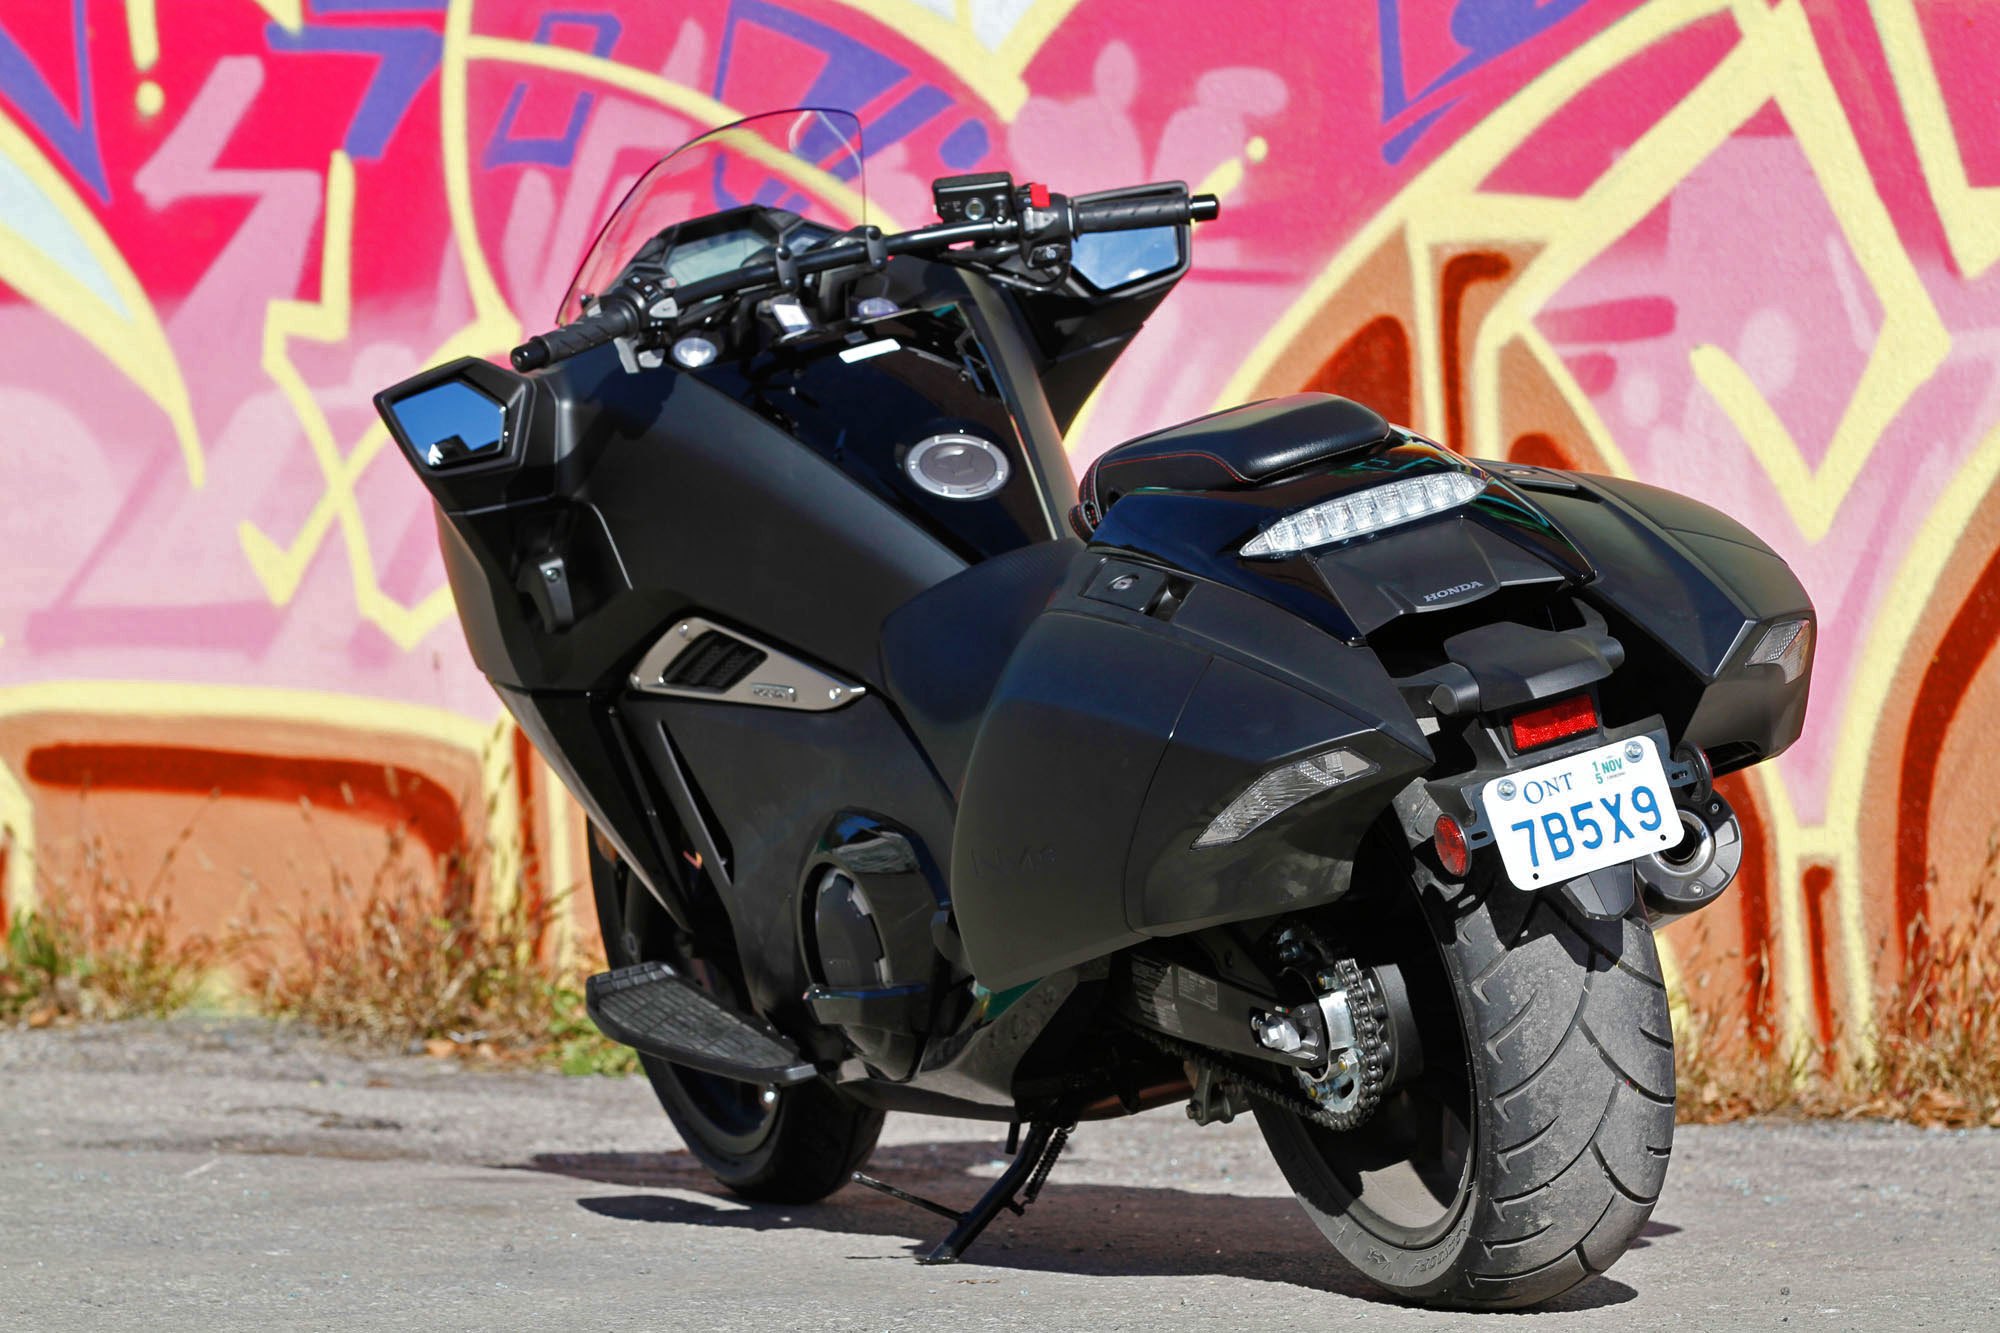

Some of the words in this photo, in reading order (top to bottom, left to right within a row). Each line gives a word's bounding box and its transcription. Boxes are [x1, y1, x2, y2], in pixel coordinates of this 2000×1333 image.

[1424, 581, 1484, 602] HONDA
[1601, 757, 1623, 774] NOV
[1511, 785, 1662, 868] 7B5X9
